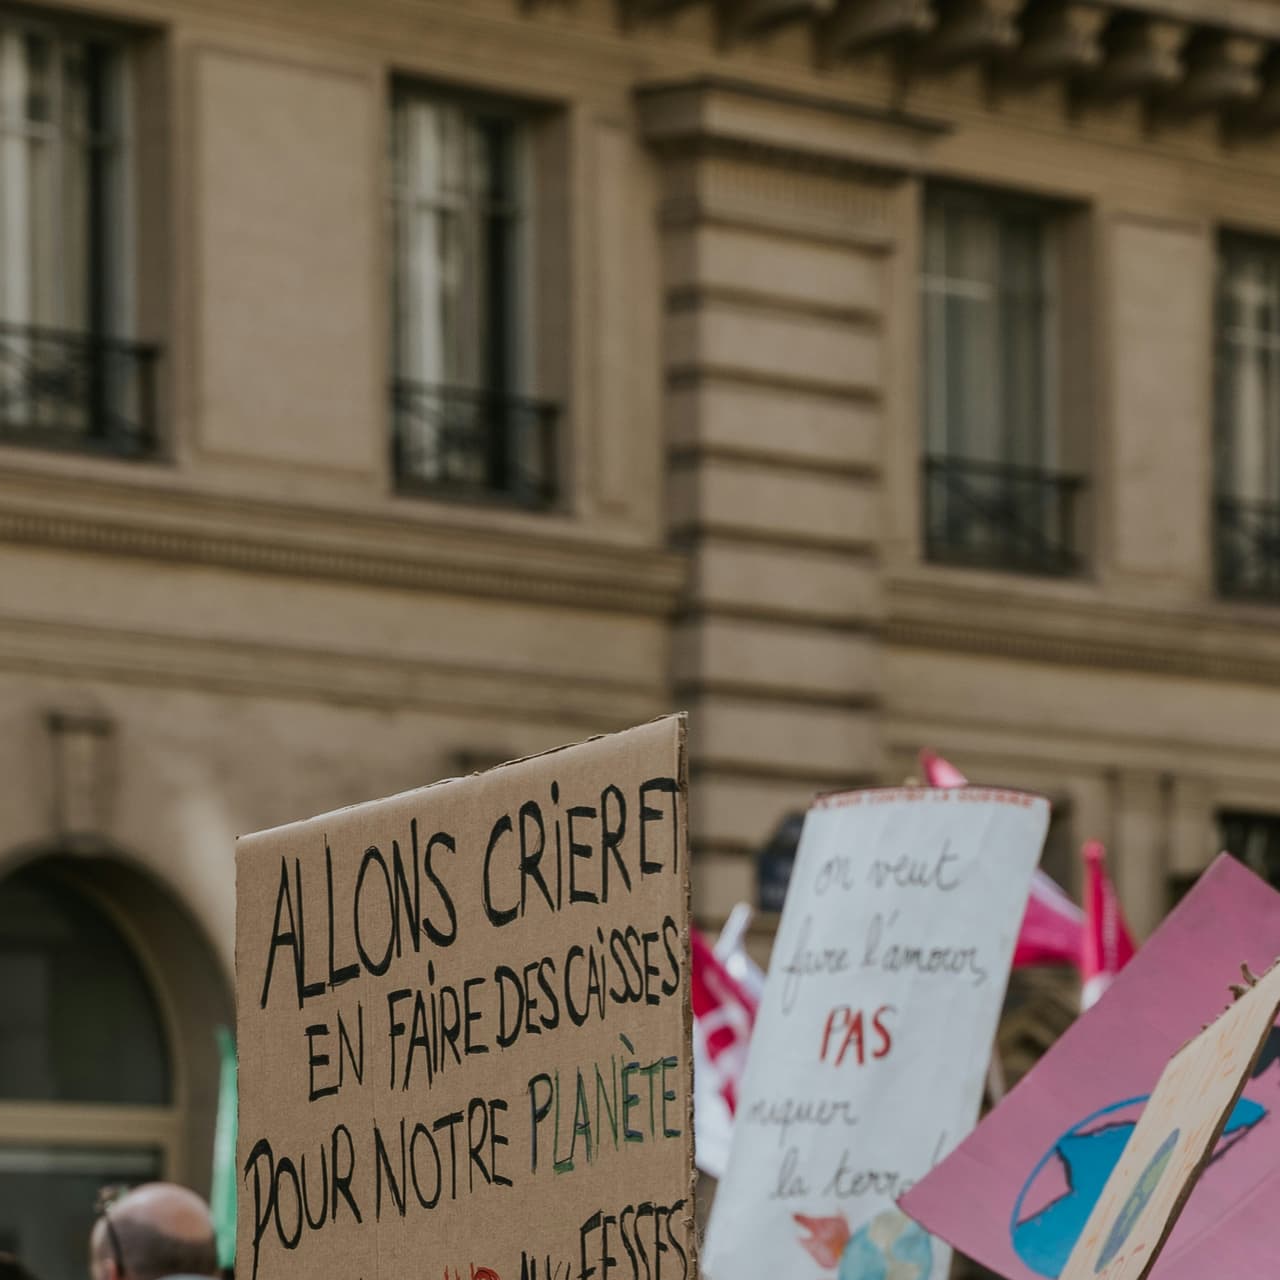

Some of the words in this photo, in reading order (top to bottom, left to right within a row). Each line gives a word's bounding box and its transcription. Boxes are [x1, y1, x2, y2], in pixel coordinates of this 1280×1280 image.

[261, 818, 458, 1010] ALLONS
[639, 777, 679, 875] ET
[868, 838, 960, 891] veut
[305, 1001, 363, 1101] EN
[495, 957, 560, 1053] DES
[820, 1003, 898, 1068] PAS
[374, 1097, 513, 1222] NOTRE
[527, 1034, 682, 1174] PLANÈTE
[747, 1098, 860, 1147] niquer
[770, 1146, 809, 1200] la
